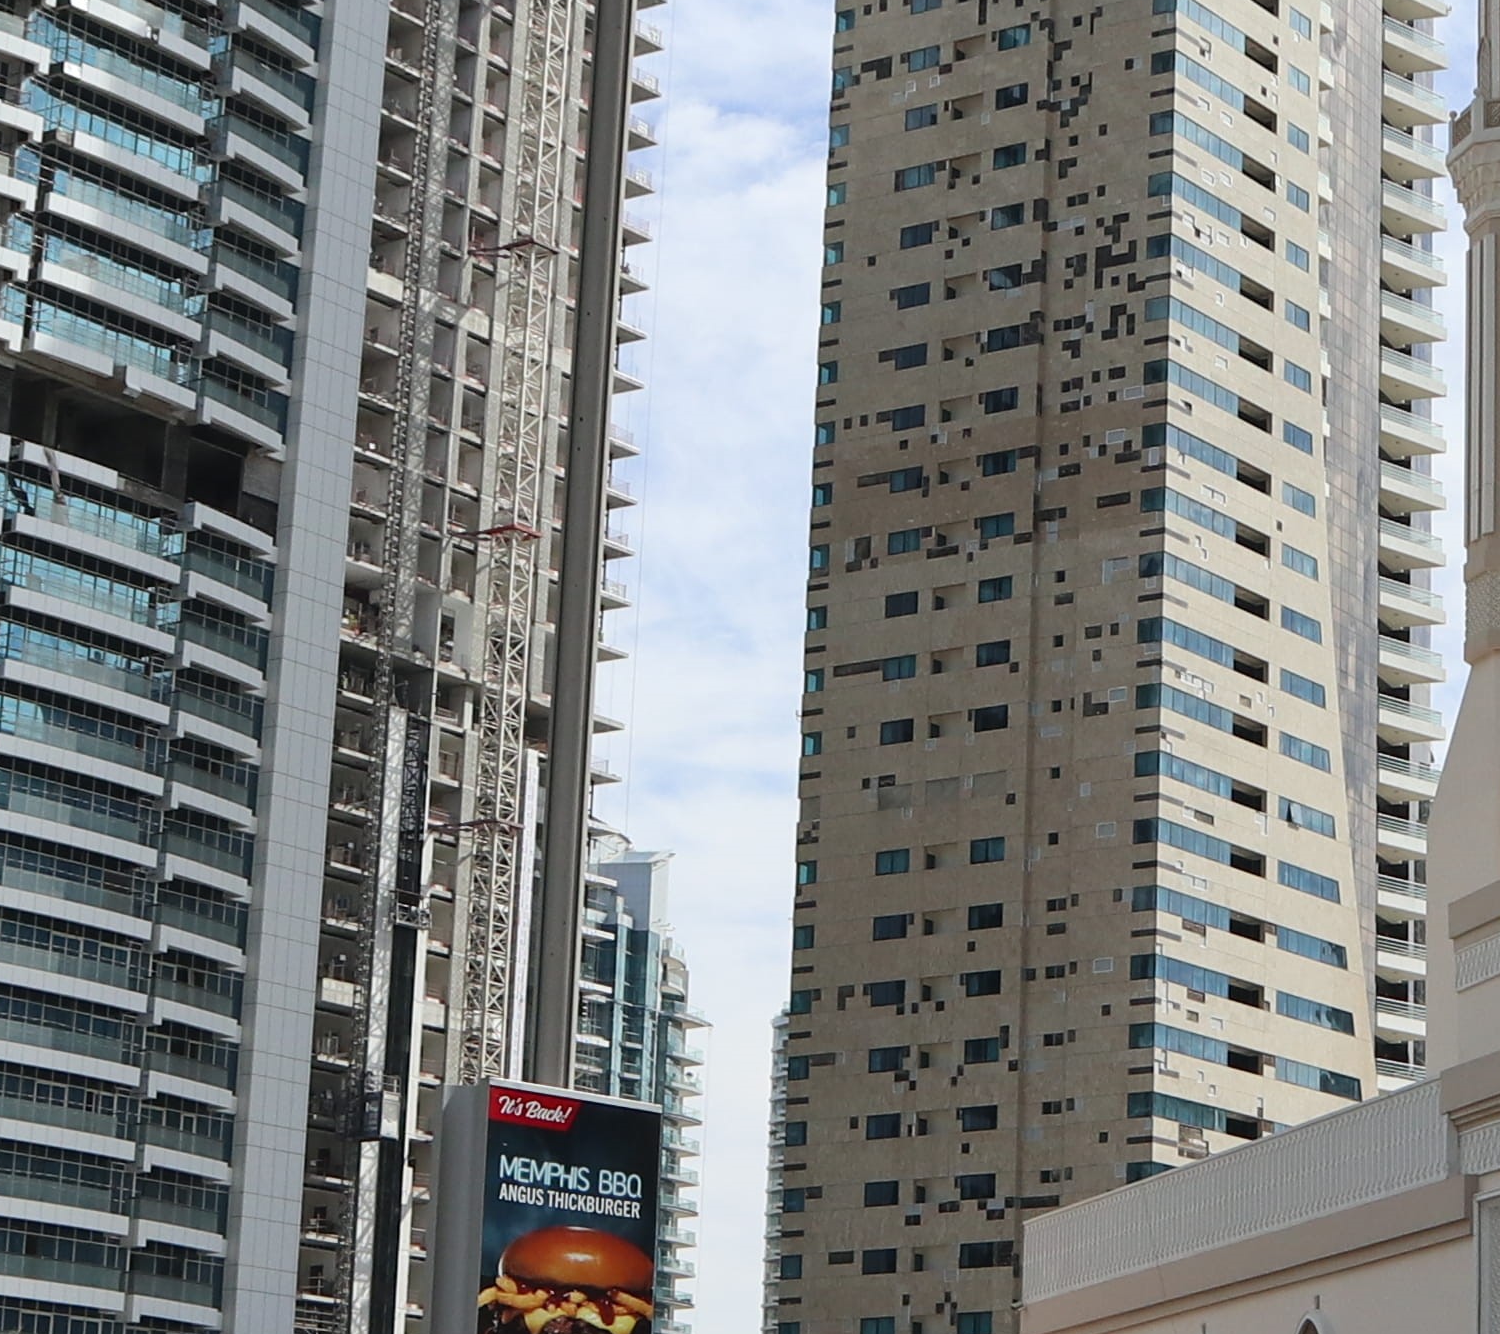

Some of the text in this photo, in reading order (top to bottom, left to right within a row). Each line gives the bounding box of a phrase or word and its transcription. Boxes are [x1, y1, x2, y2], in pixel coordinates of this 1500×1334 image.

[498, 1095, 573, 1124] It's Back!
[499, 1154, 643, 1199] MEMPHIS BBQ
[498, 1182, 641, 1220] ANGUS THICKBURGER
